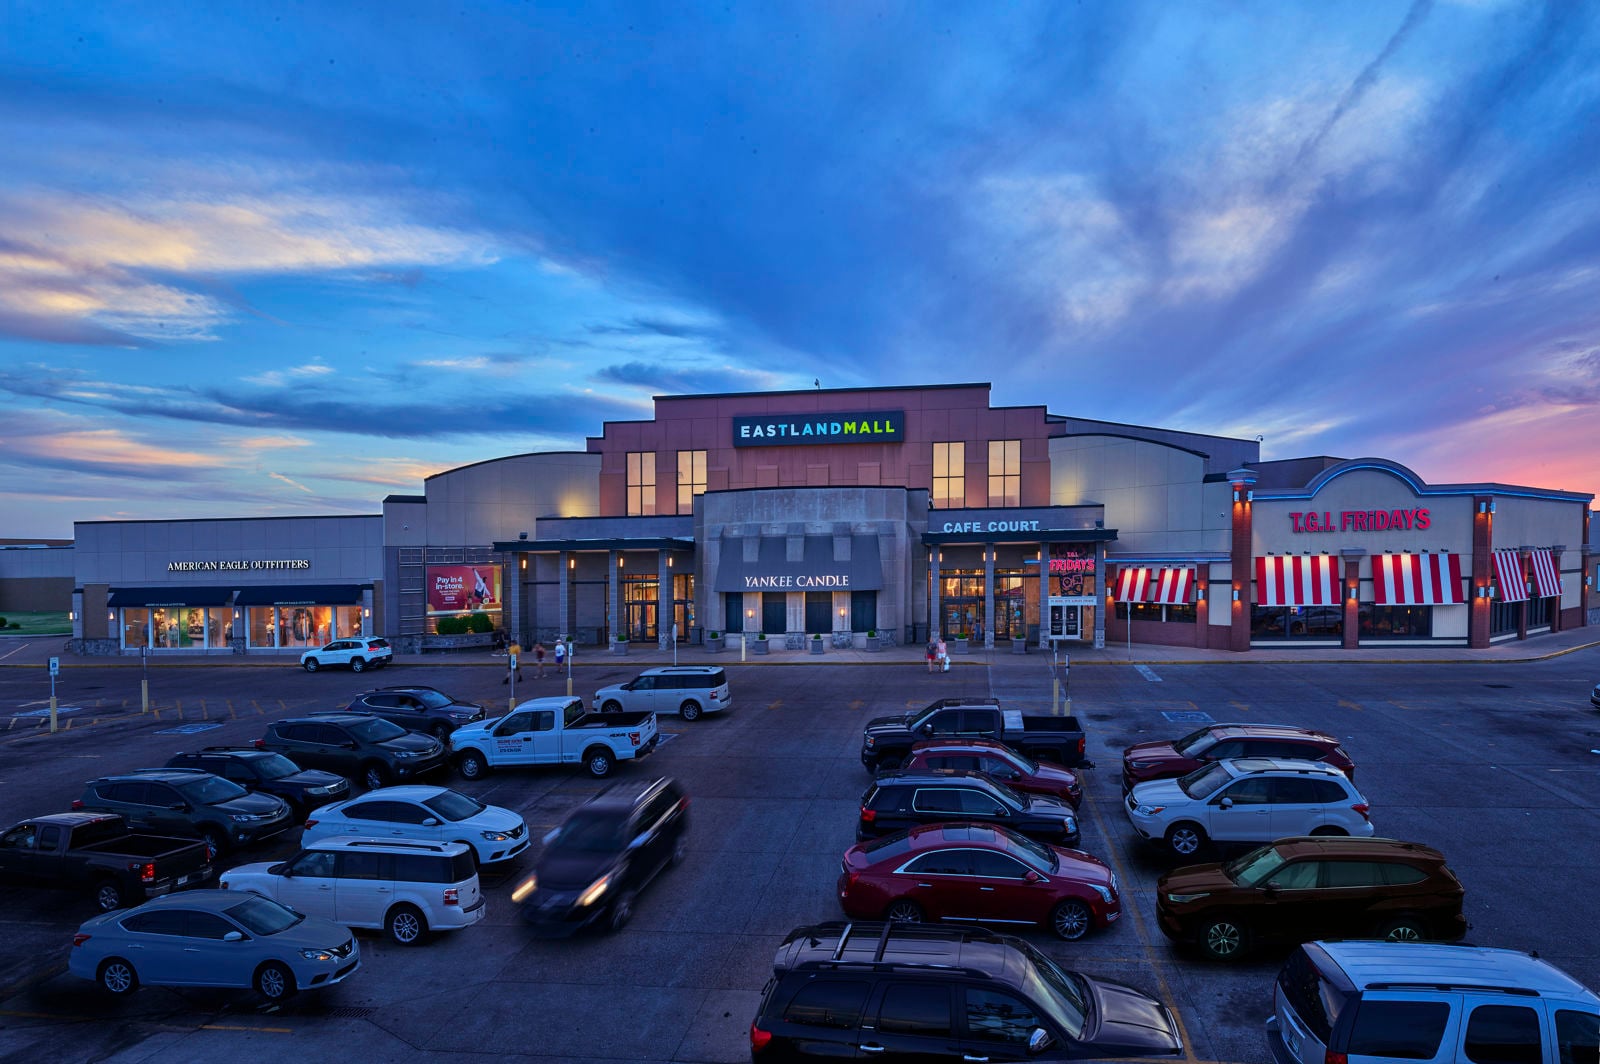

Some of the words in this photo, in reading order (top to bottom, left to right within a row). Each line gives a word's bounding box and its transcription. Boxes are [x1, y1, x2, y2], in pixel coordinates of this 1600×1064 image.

[943, 521, 981, 533] CAFE
[987, 520, 1039, 532] COURT
[167, 561, 217, 571] AMERICAN
[219, 560, 249, 570] EAGLE
[251, 559, 309, 569] OUTFITTERS
[435, 582, 464, 590] in-store.
[437, 576, 449, 584] Pay
[744, 576, 793, 588] YANKEE
[796, 575, 849, 587] CANDLE
